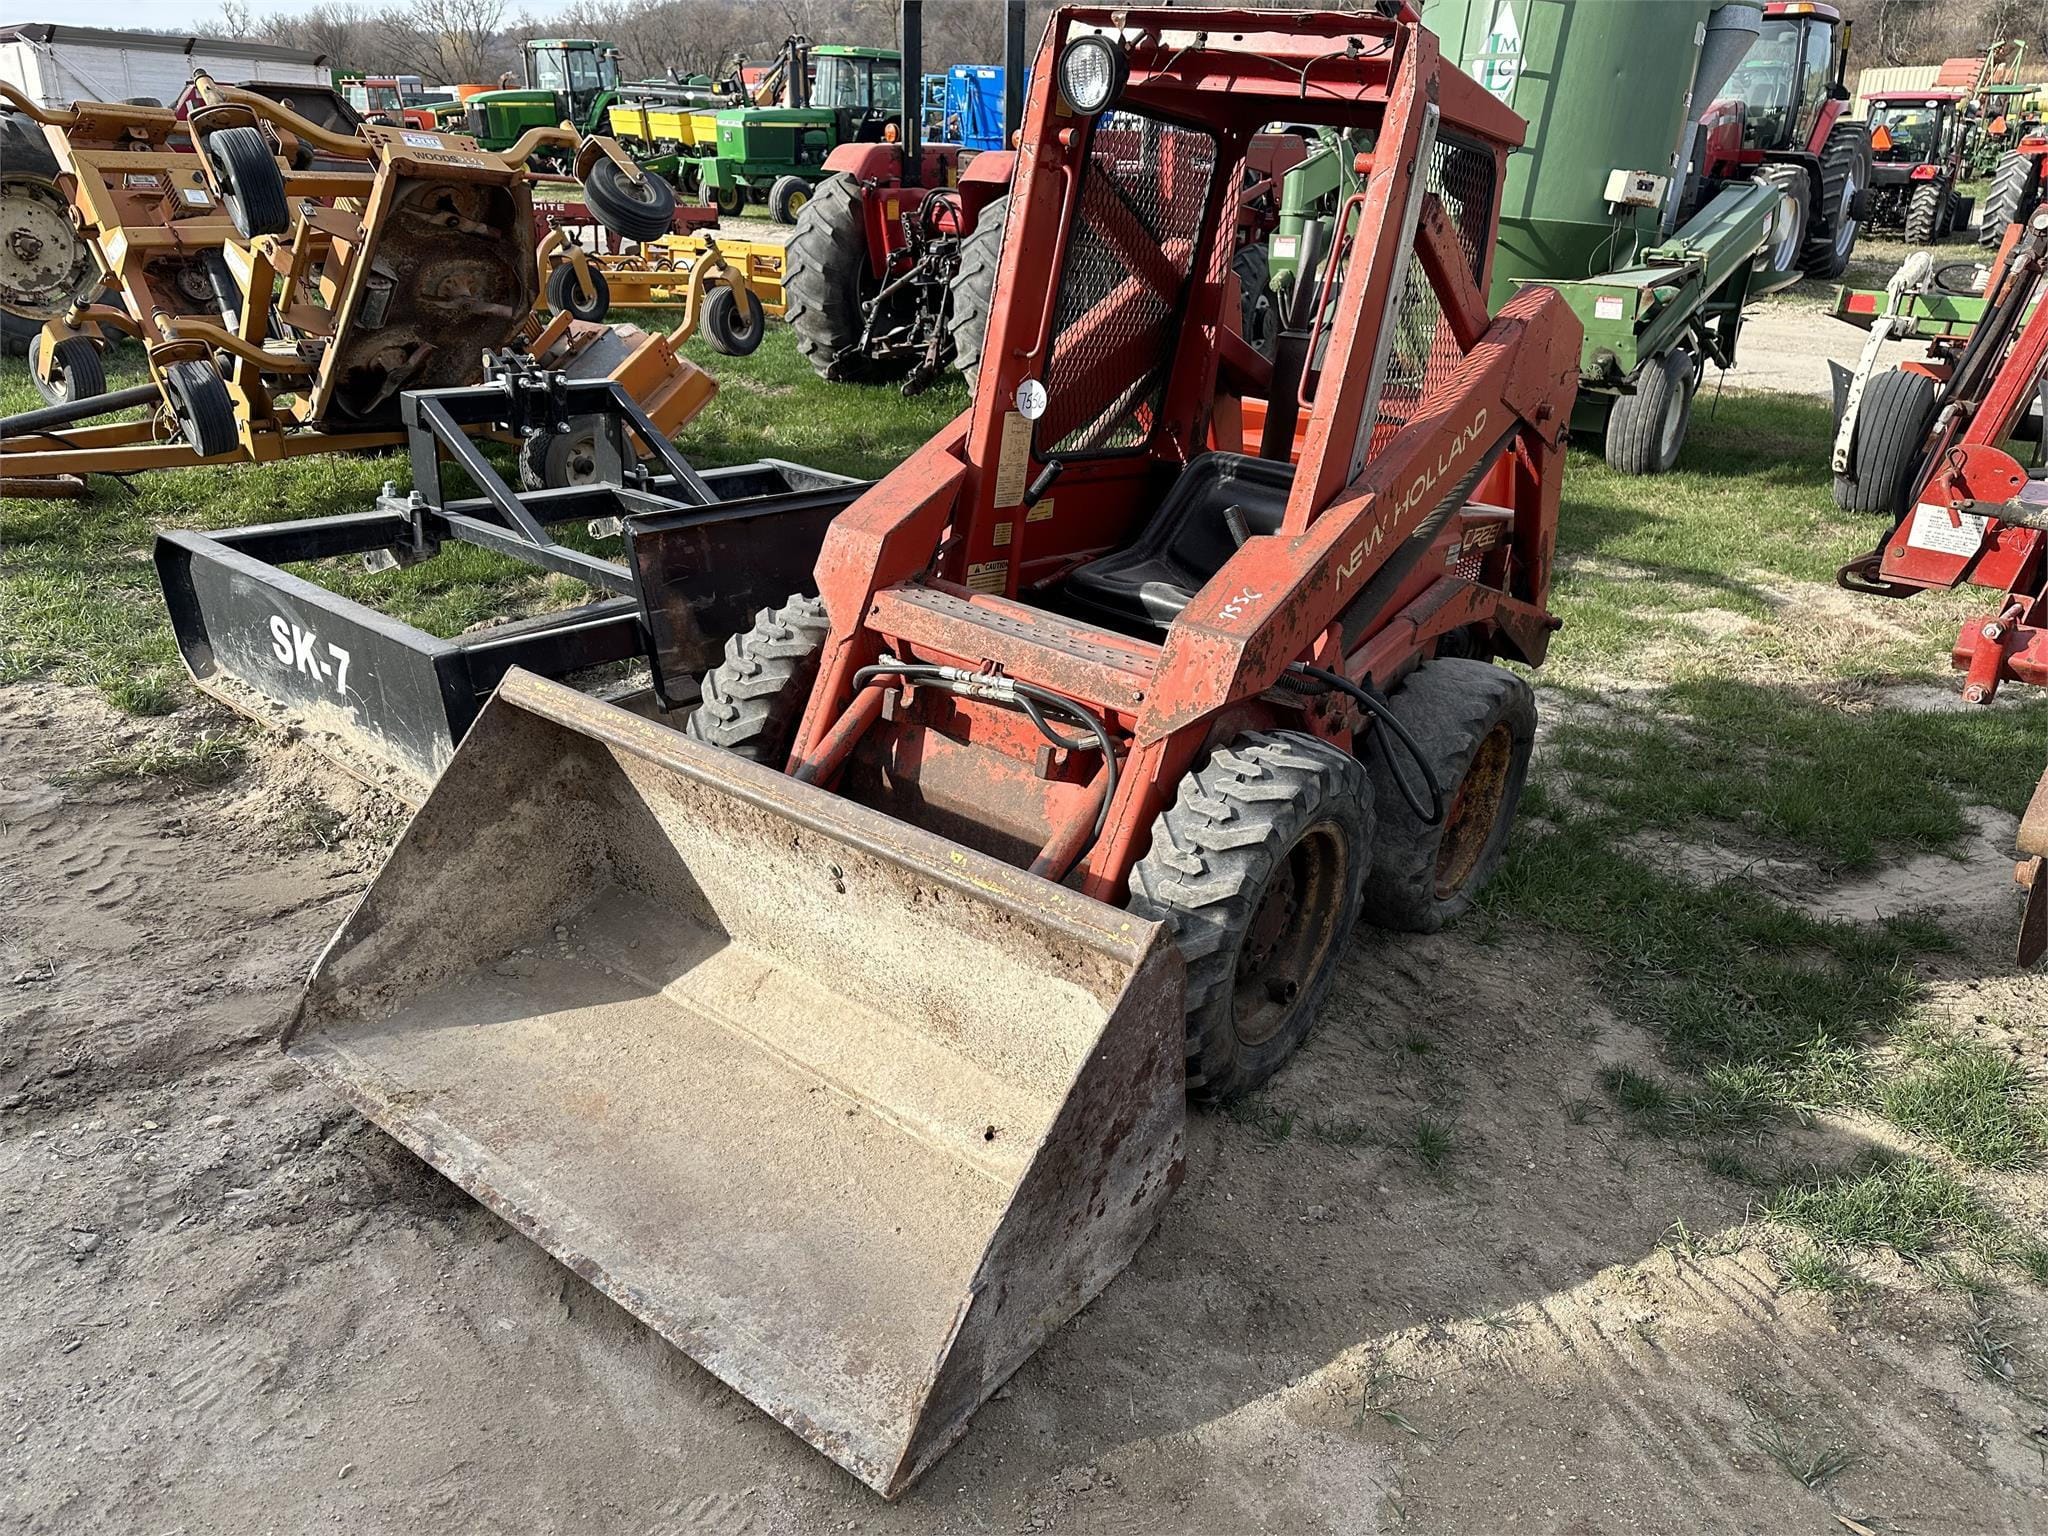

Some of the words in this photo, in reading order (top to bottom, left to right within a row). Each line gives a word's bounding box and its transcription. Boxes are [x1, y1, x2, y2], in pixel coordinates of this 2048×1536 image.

[413, 151, 459, 164] WOODS
[533, 203, 565, 211] HITE
[1018, 391, 1045, 411] 7556
[1336, 514, 1389, 592] NEW
[1393, 407, 1488, 528] HOLLAND
[269, 614, 350, 696] SK-7
